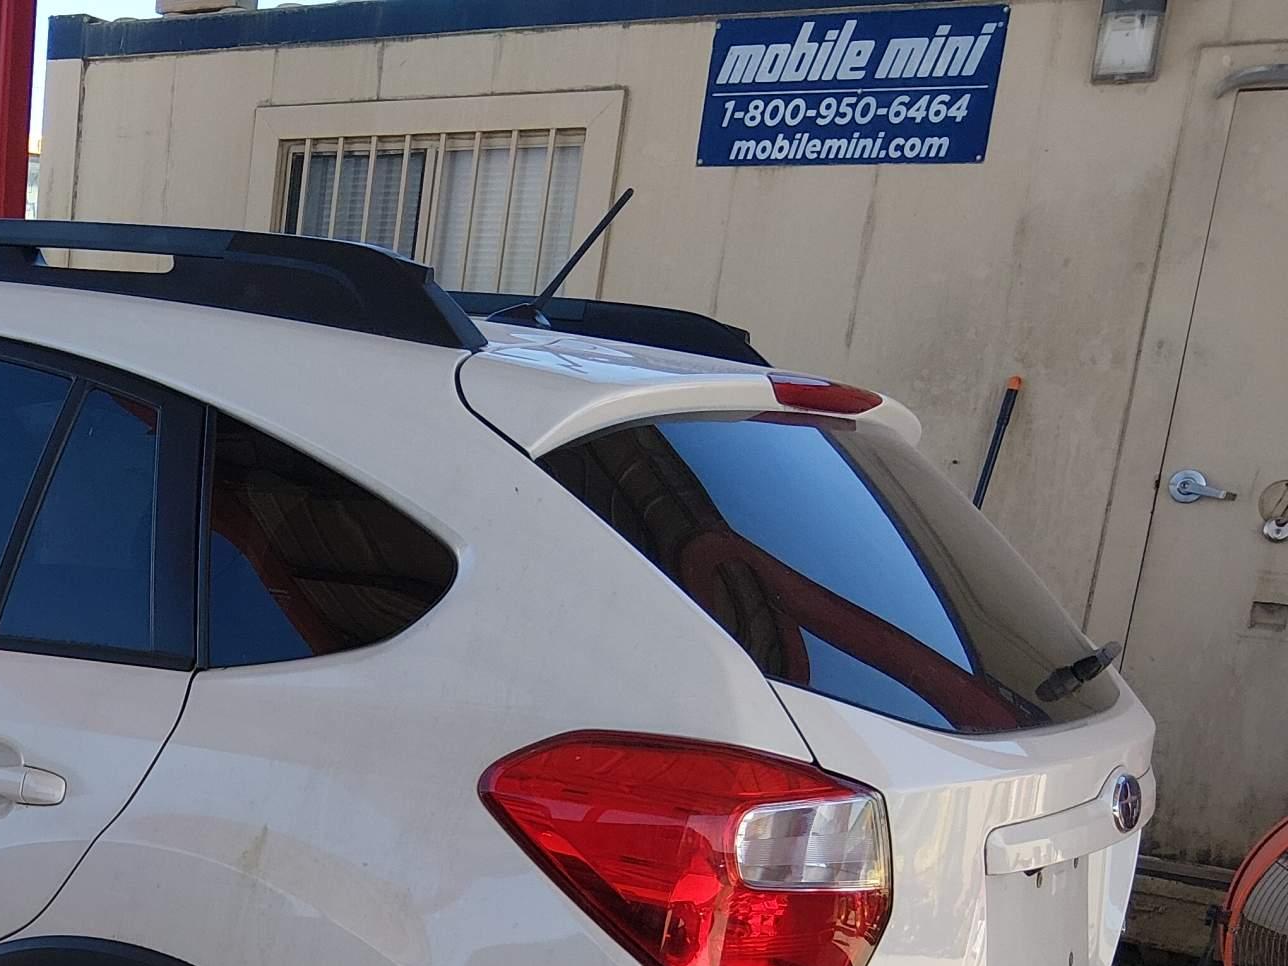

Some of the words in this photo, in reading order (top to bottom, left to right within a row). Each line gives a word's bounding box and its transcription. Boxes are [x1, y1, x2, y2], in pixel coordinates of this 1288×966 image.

[716, 19, 875, 84] mobile
[874, 22, 997, 79] mini
[721, 94, 971, 128] 1-800-950-6464
[729, 132, 950, 160] mobilemini.com
